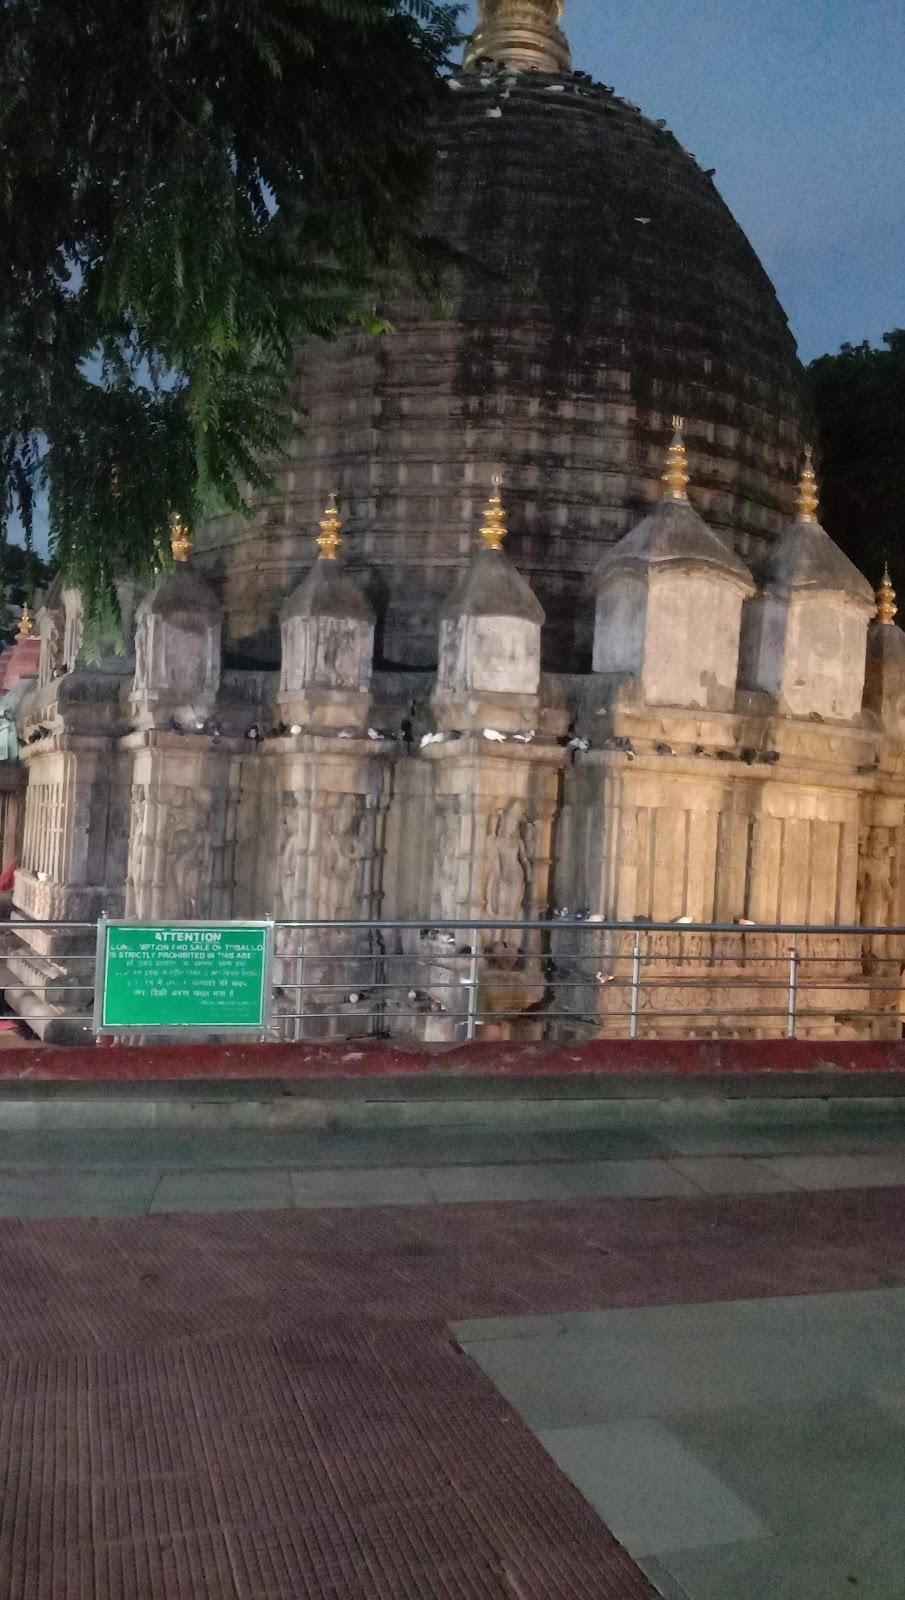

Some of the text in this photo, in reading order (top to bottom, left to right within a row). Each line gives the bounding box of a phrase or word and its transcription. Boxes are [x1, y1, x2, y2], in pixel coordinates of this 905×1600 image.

[155, 931, 222, 942] ATTENTION
[118, 951, 156, 959] STRICTLY
[158, 952, 206, 960] PROHIBITED
[207, 952, 216, 960] IN
